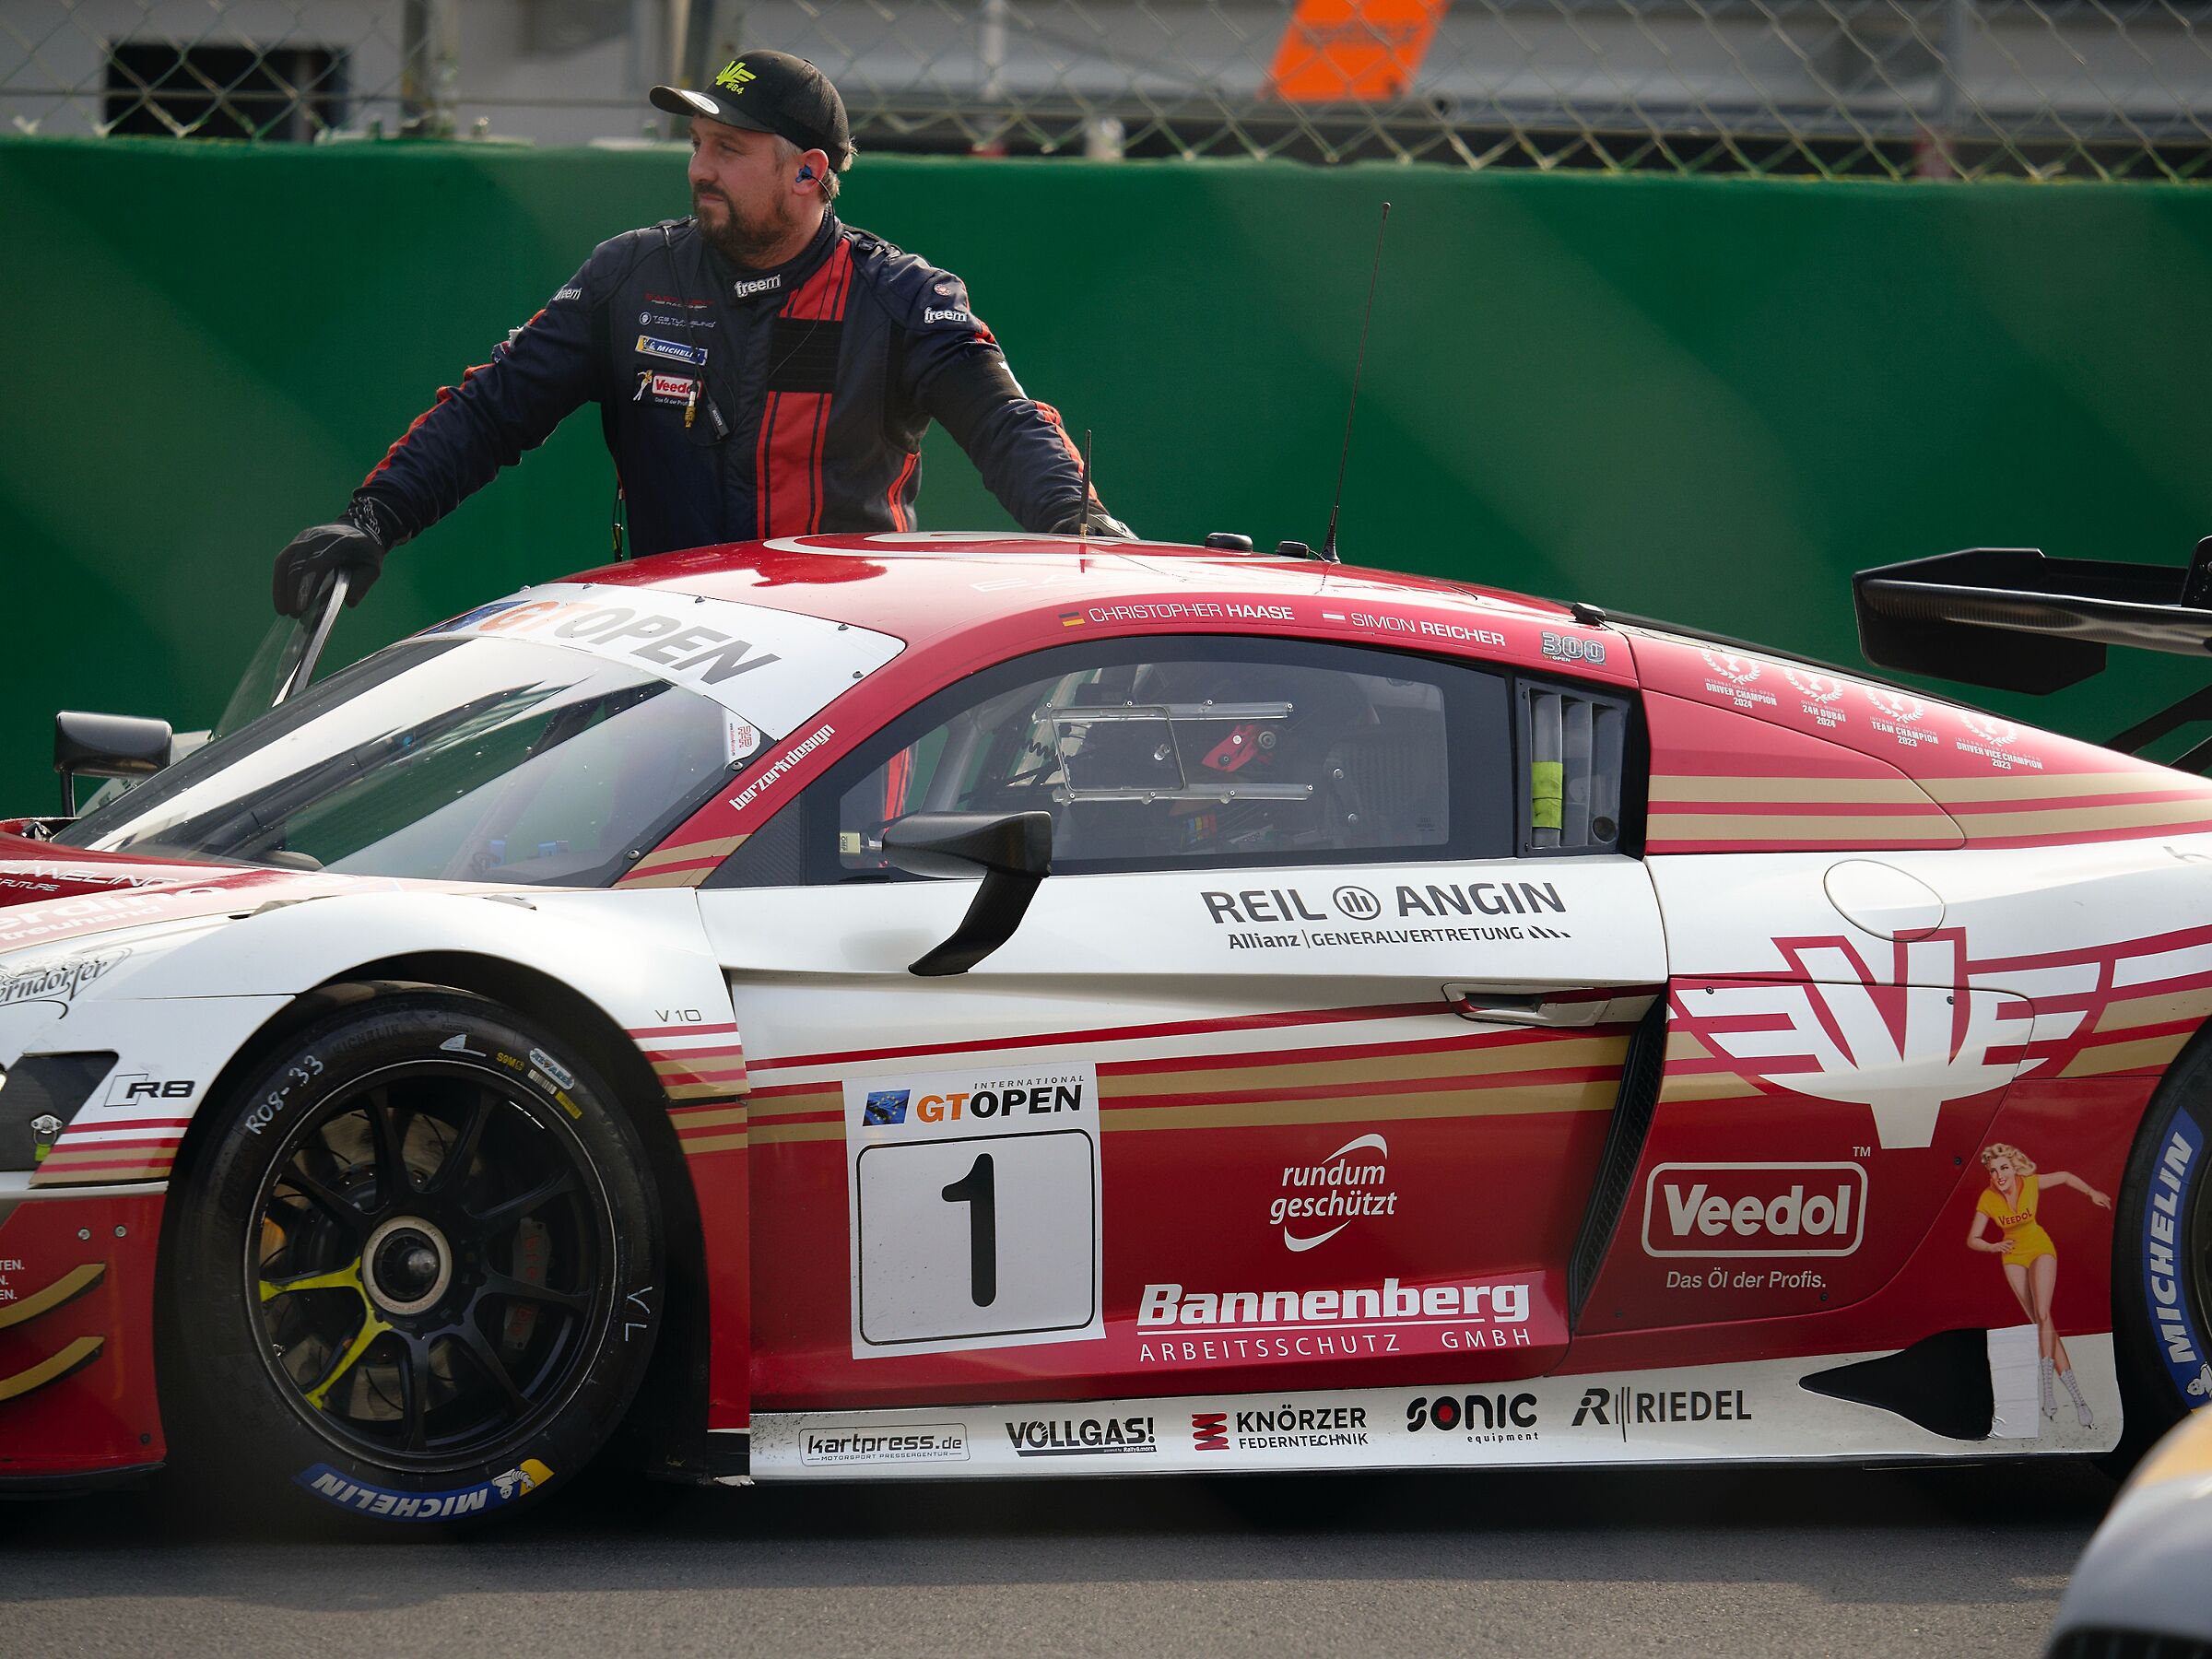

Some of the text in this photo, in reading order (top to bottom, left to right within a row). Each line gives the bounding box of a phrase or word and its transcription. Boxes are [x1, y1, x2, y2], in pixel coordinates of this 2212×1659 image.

[735, 274, 782, 298] freem
[924, 307, 968, 324] freem
[1088, 603, 1296, 623] CHRISTOPHER HAASE
[1351, 612, 1506, 647] SIMON REICHER
[1541, 630, 1606, 664] 300
[1705, 682, 1778, 706] DRIVER CHAMPION
[1733, 697, 1753, 709] 2024
[1802, 704, 1847, 723] 24H DUBAI
[1816, 715, 1837, 728] 2024
[1871, 721, 1939, 745] TEAM CHAMPION
[1897, 735, 1918, 747] 2023
[1956, 741, 2043, 770] DRIVER VICE CHAMPION
[1991, 758, 2012, 771] 2023
[1200, 882, 1567, 924] REIL ANGIN
[1228, 926, 1524, 950] Allianz GENERALVERTRETUNG
[654, 1009, 702, 1022] V10
[125, 1080, 195, 1100] R8
[973, 1075, 1085, 1089] INTERNATIONAL
[1853, 1146, 1871, 1157] TM
[1281, 1158, 1386, 1187] rundum
[1269, 1189, 1398, 1225] geschützt
[1663, 1183, 1852, 1236] Veedol
[1997, 1207, 2032, 1227] VEEDOL
[941, 1152, 997, 1308] 1
[2149, 1131, 2194, 1364] MICHELIN
[1666, 1266, 1828, 1289] Das Öl der Profis.
[1135, 1277, 1531, 1327] Bannenberg
[1139, 1328, 1532, 1362] ARBEITSSCHUTZ GMBH
[1236, 1404, 1368, 1433] KNÖRZER
[1637, 1389, 1752, 1425] RIEDEL
[807, 1433, 962, 1454] kartpress.de
[1005, 1417, 1156, 1449] VOLLGAS!
[1239, 1432, 1370, 1450] FEDERNTECHNIK
[1467, 1431, 1539, 1444] equipment
[311, 1472, 488, 1519] MICHELIN
